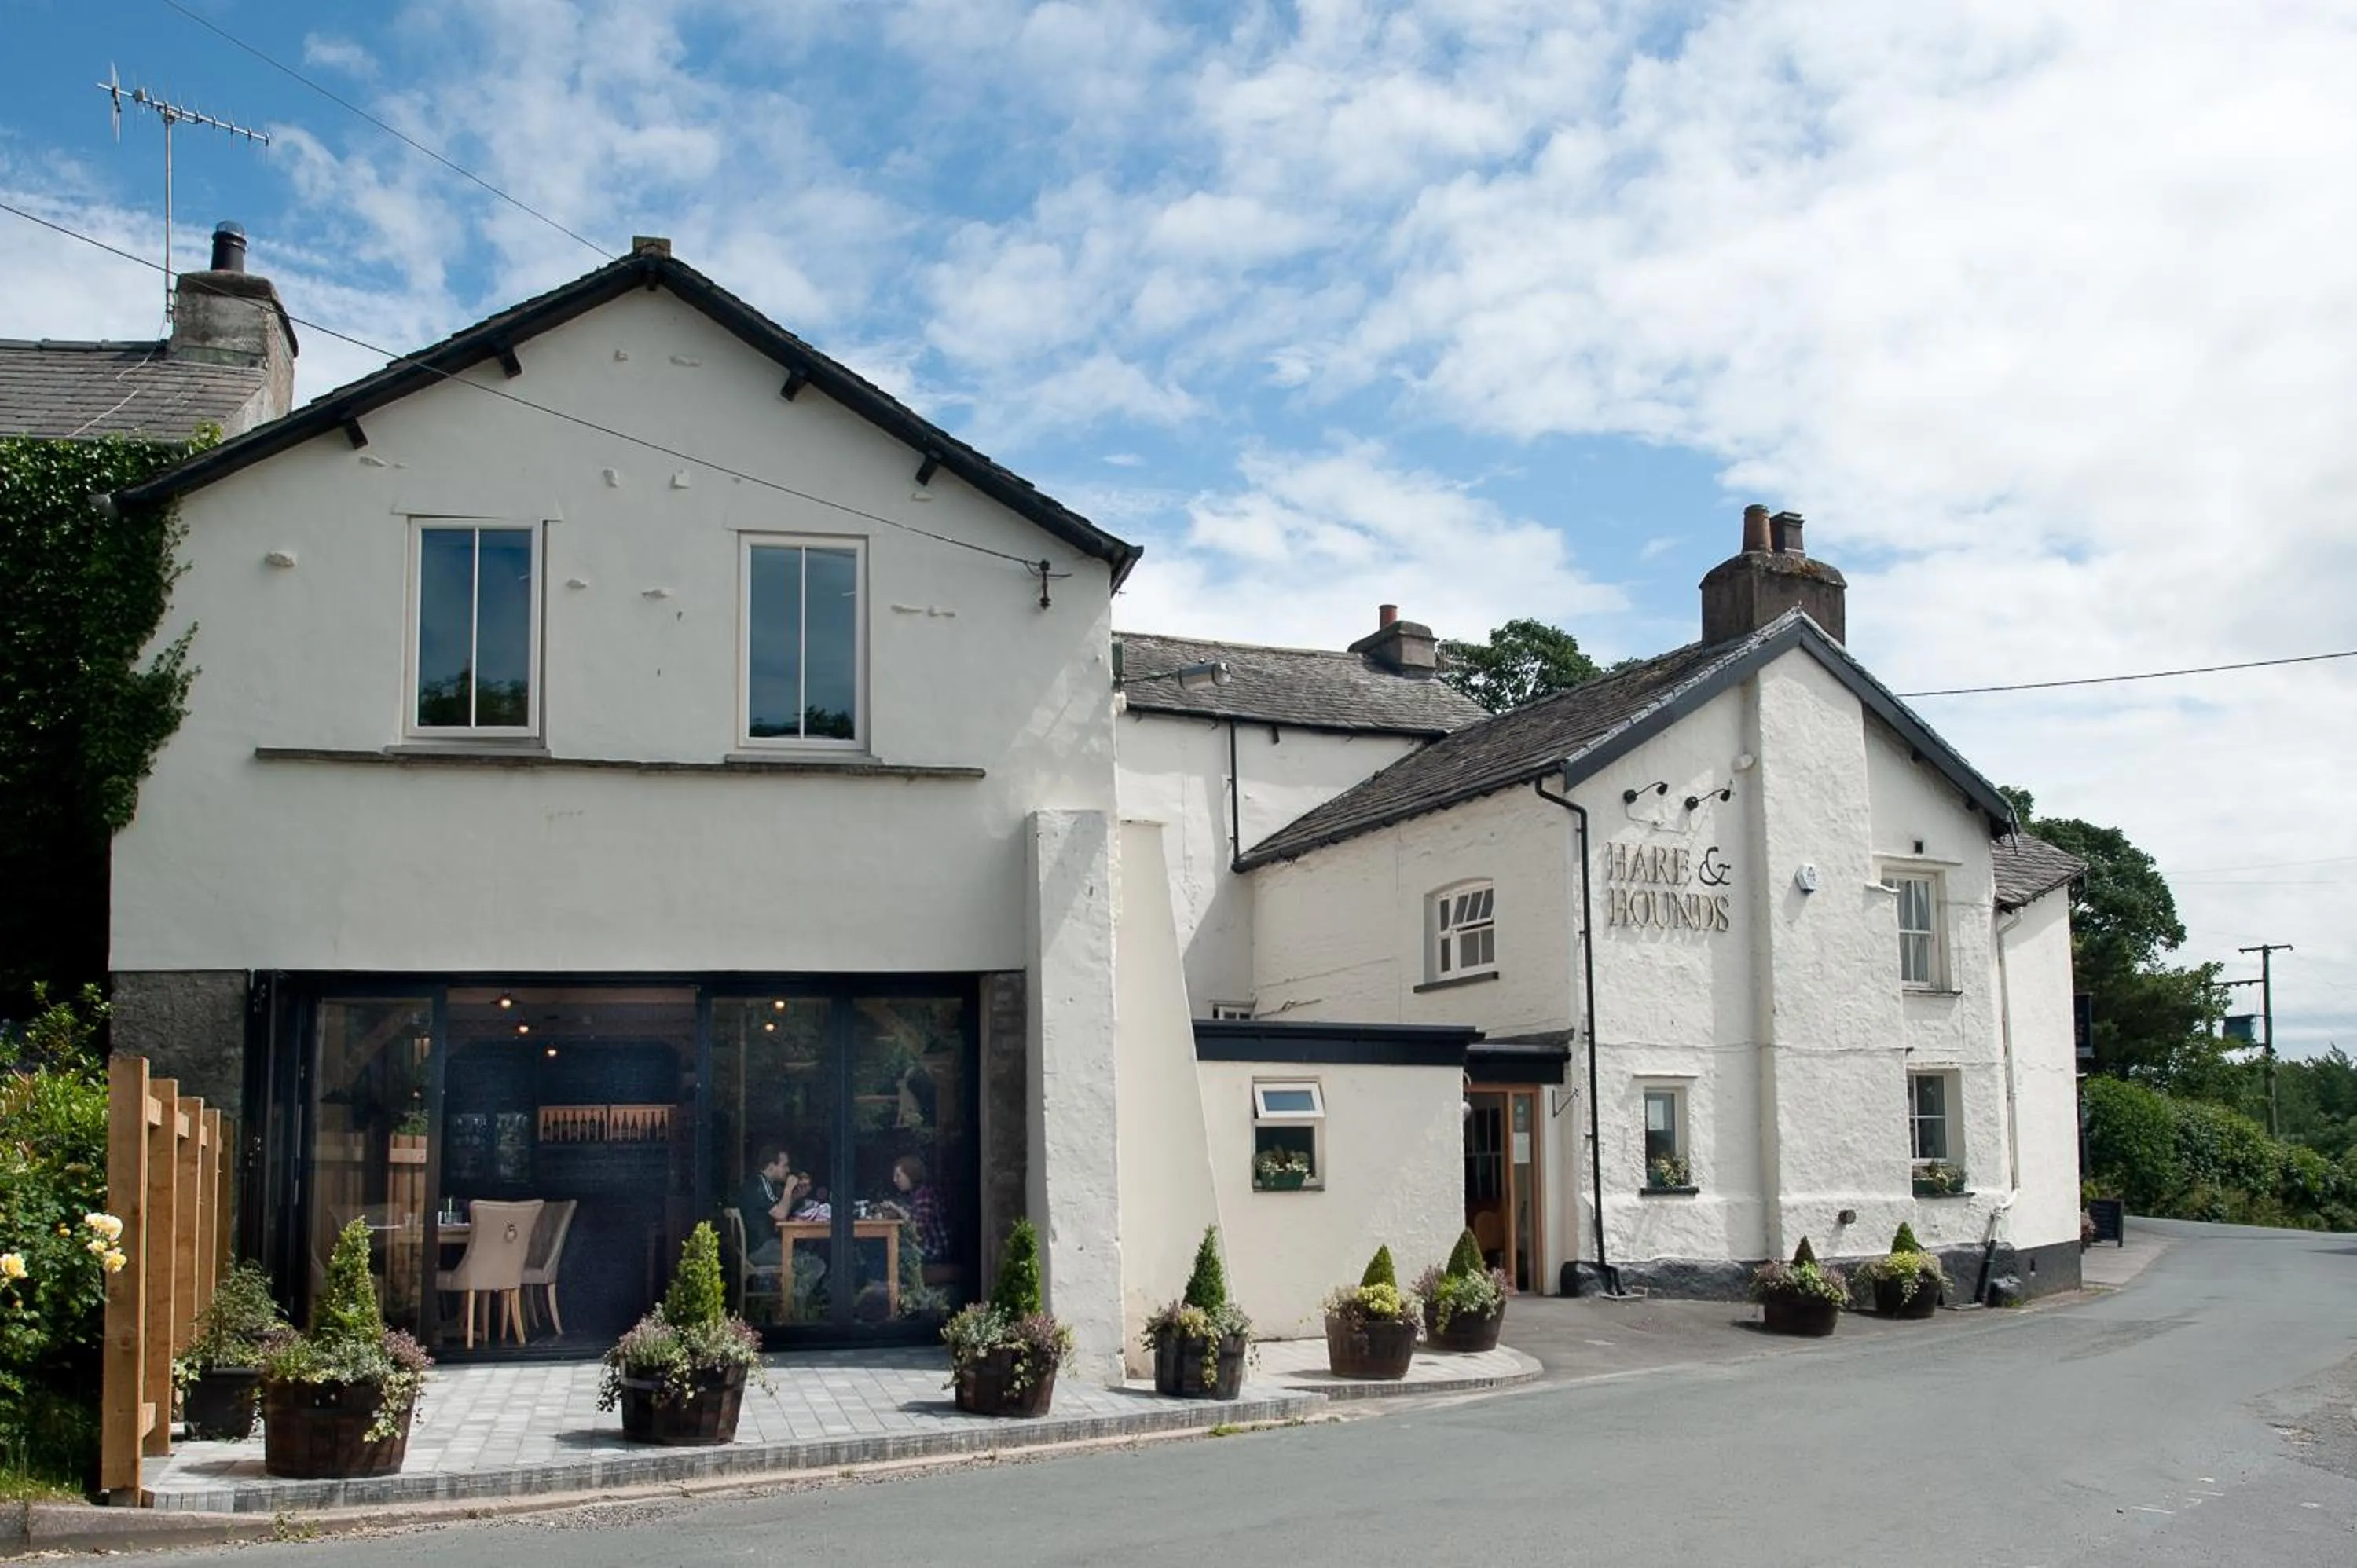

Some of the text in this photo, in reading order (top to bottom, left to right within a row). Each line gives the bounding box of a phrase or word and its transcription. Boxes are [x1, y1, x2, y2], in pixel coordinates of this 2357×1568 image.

[1607, 841, 1731, 886] HARE &
[1608, 888, 1730, 932] HOUNDS
